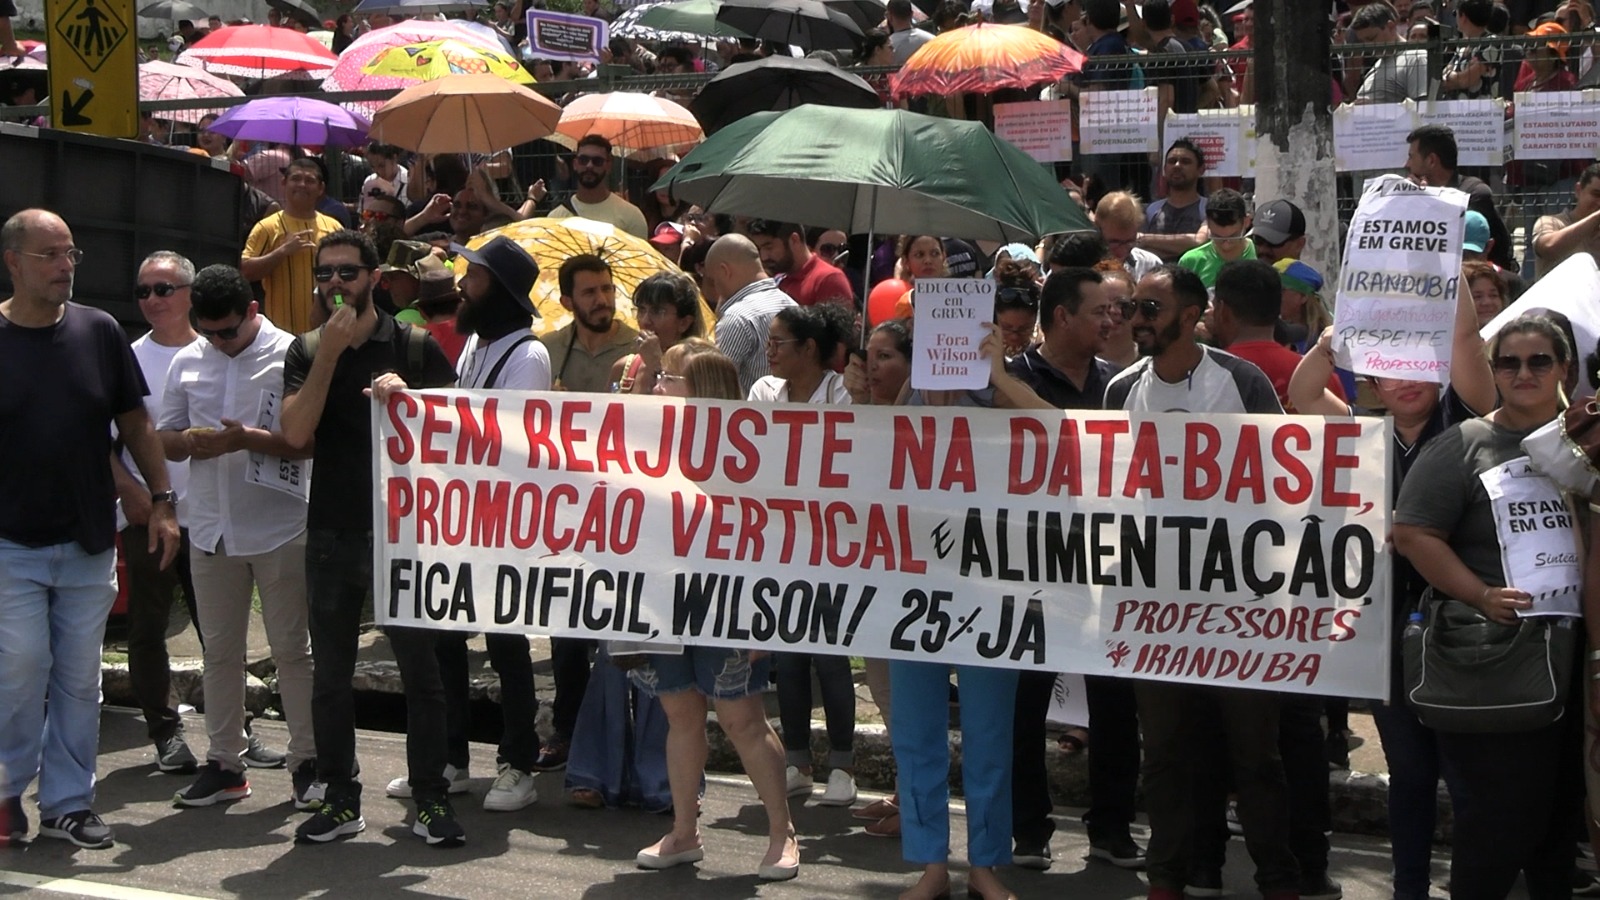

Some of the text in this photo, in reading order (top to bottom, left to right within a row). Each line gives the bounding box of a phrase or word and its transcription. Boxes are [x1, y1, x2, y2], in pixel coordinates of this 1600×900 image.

[1363, 219, 1448, 236] ESTAMOS
[1358, 236, 1448, 252] EM GREVE
[917, 281, 992, 296] EDUCAÇÃO
[1346, 271, 1459, 300] IRANDUBA
[944, 297, 963, 306] em
[931, 308, 976, 319] GREVE
[936, 334, 969, 346] Fora
[1339, 326, 1447, 348] RESPEITE
[927, 348, 977, 361] Wilson
[1365, 350, 1449, 371] PROFESSORES
[932, 363, 968, 376] Lima
[386, 393, 1374, 516] SEM REAJUSTE NA DATA-BASE,
[290, 464, 300, 486] EM
[1508, 499, 1569, 516] ESTAM
[1509, 518, 1538, 533] EM
[387, 476, 646, 559] PROMOÇÃO
[671, 490, 928, 575] VERTICAL
[959, 507, 1375, 607] ALIMENTAÇÃO,
[388, 558, 477, 623] FICA
[494, 562, 660, 641] DIFÍCIL,
[672, 572, 878, 648] WILSON!
[1112, 600, 1362, 643] PROFESSORES
[1132, 643, 1322, 687] IRANDUBA
